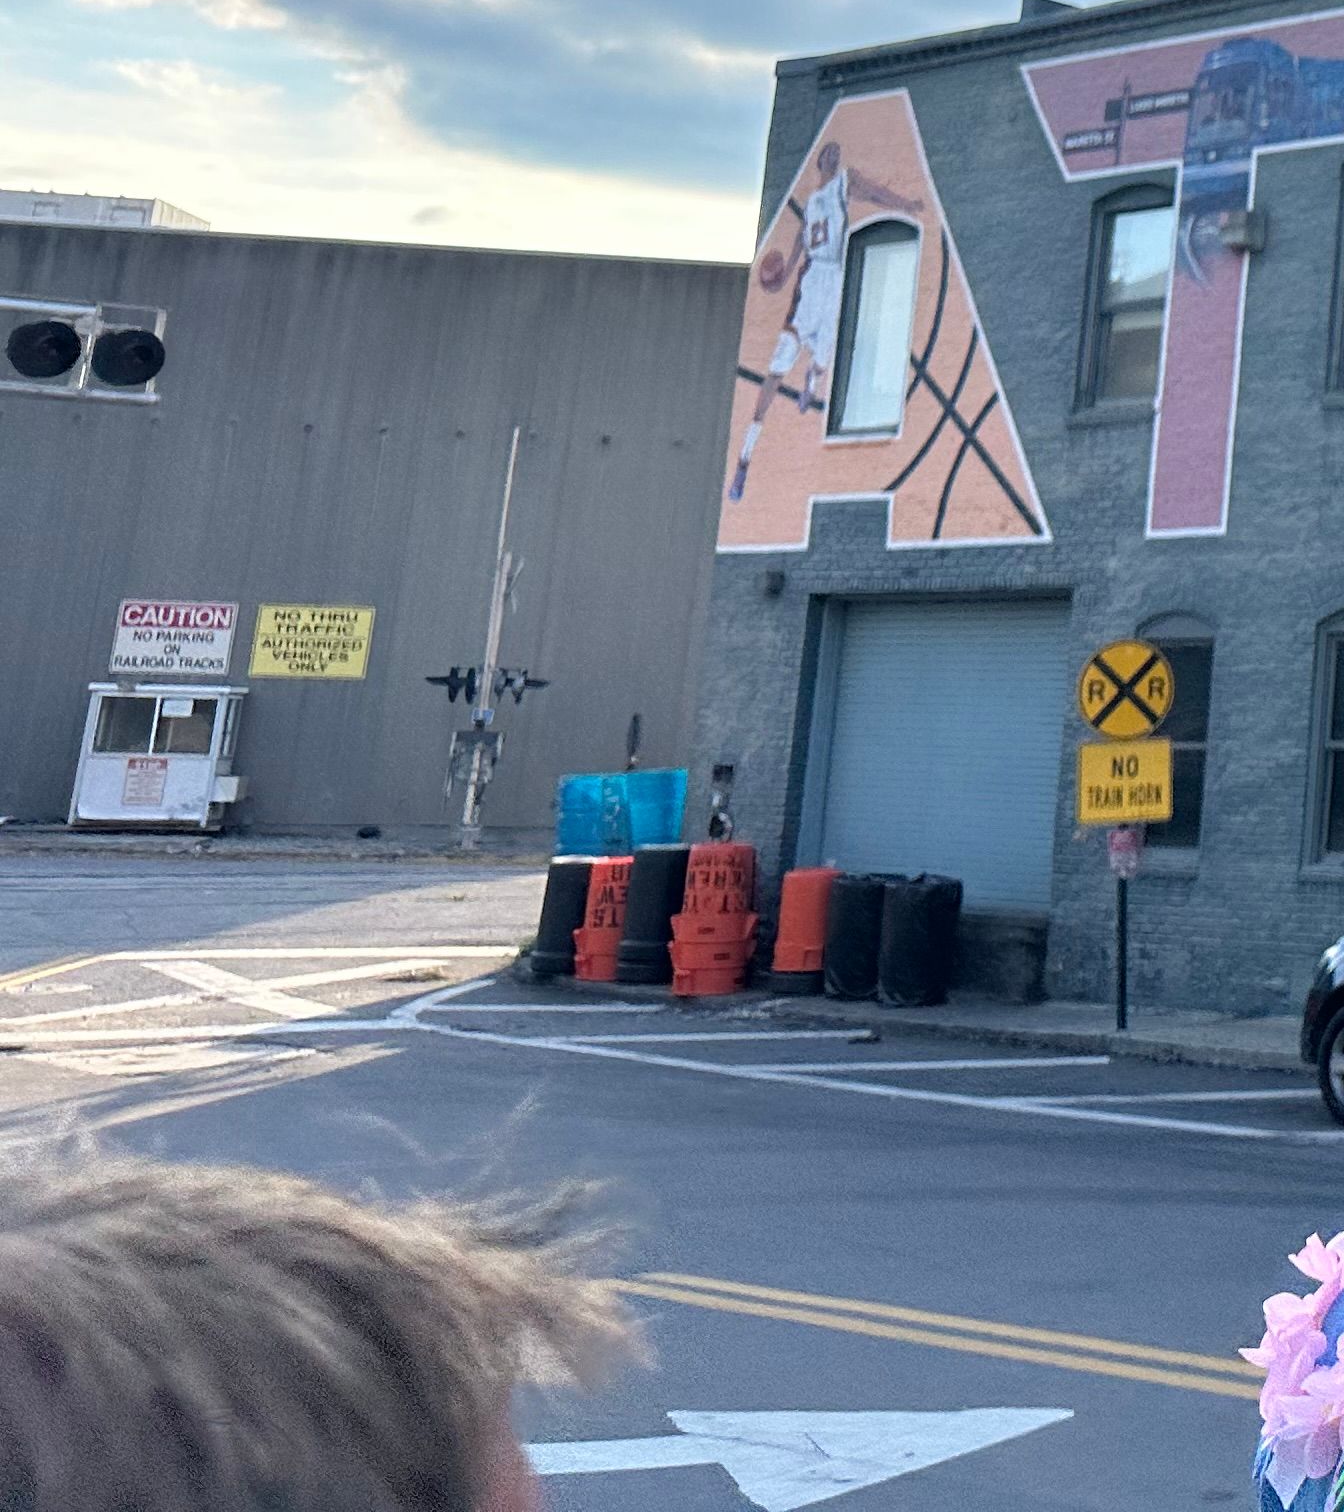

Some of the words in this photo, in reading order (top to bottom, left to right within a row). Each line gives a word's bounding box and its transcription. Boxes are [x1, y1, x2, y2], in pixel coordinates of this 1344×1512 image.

[124, 605, 231, 628] CAUTION
[273, 610, 300, 624] NO
[277, 623, 355, 636] TRAFFIC
[133, 630, 152, 642] NO
[156, 630, 214, 643] PARKING
[164, 644, 181, 655] ON
[262, 638, 362, 652] AUTHORIZED
[114, 655, 174, 667] RAILROAD
[180, 656, 224, 668] TRACKS
[272, 649, 349, 662] VEHICLES
[289, 661, 327, 672] ONLY
[1112, 755, 1139, 778] NO
[1088, 785, 1123, 809] TRAIN
[1128, 782, 1162, 806] HORN
